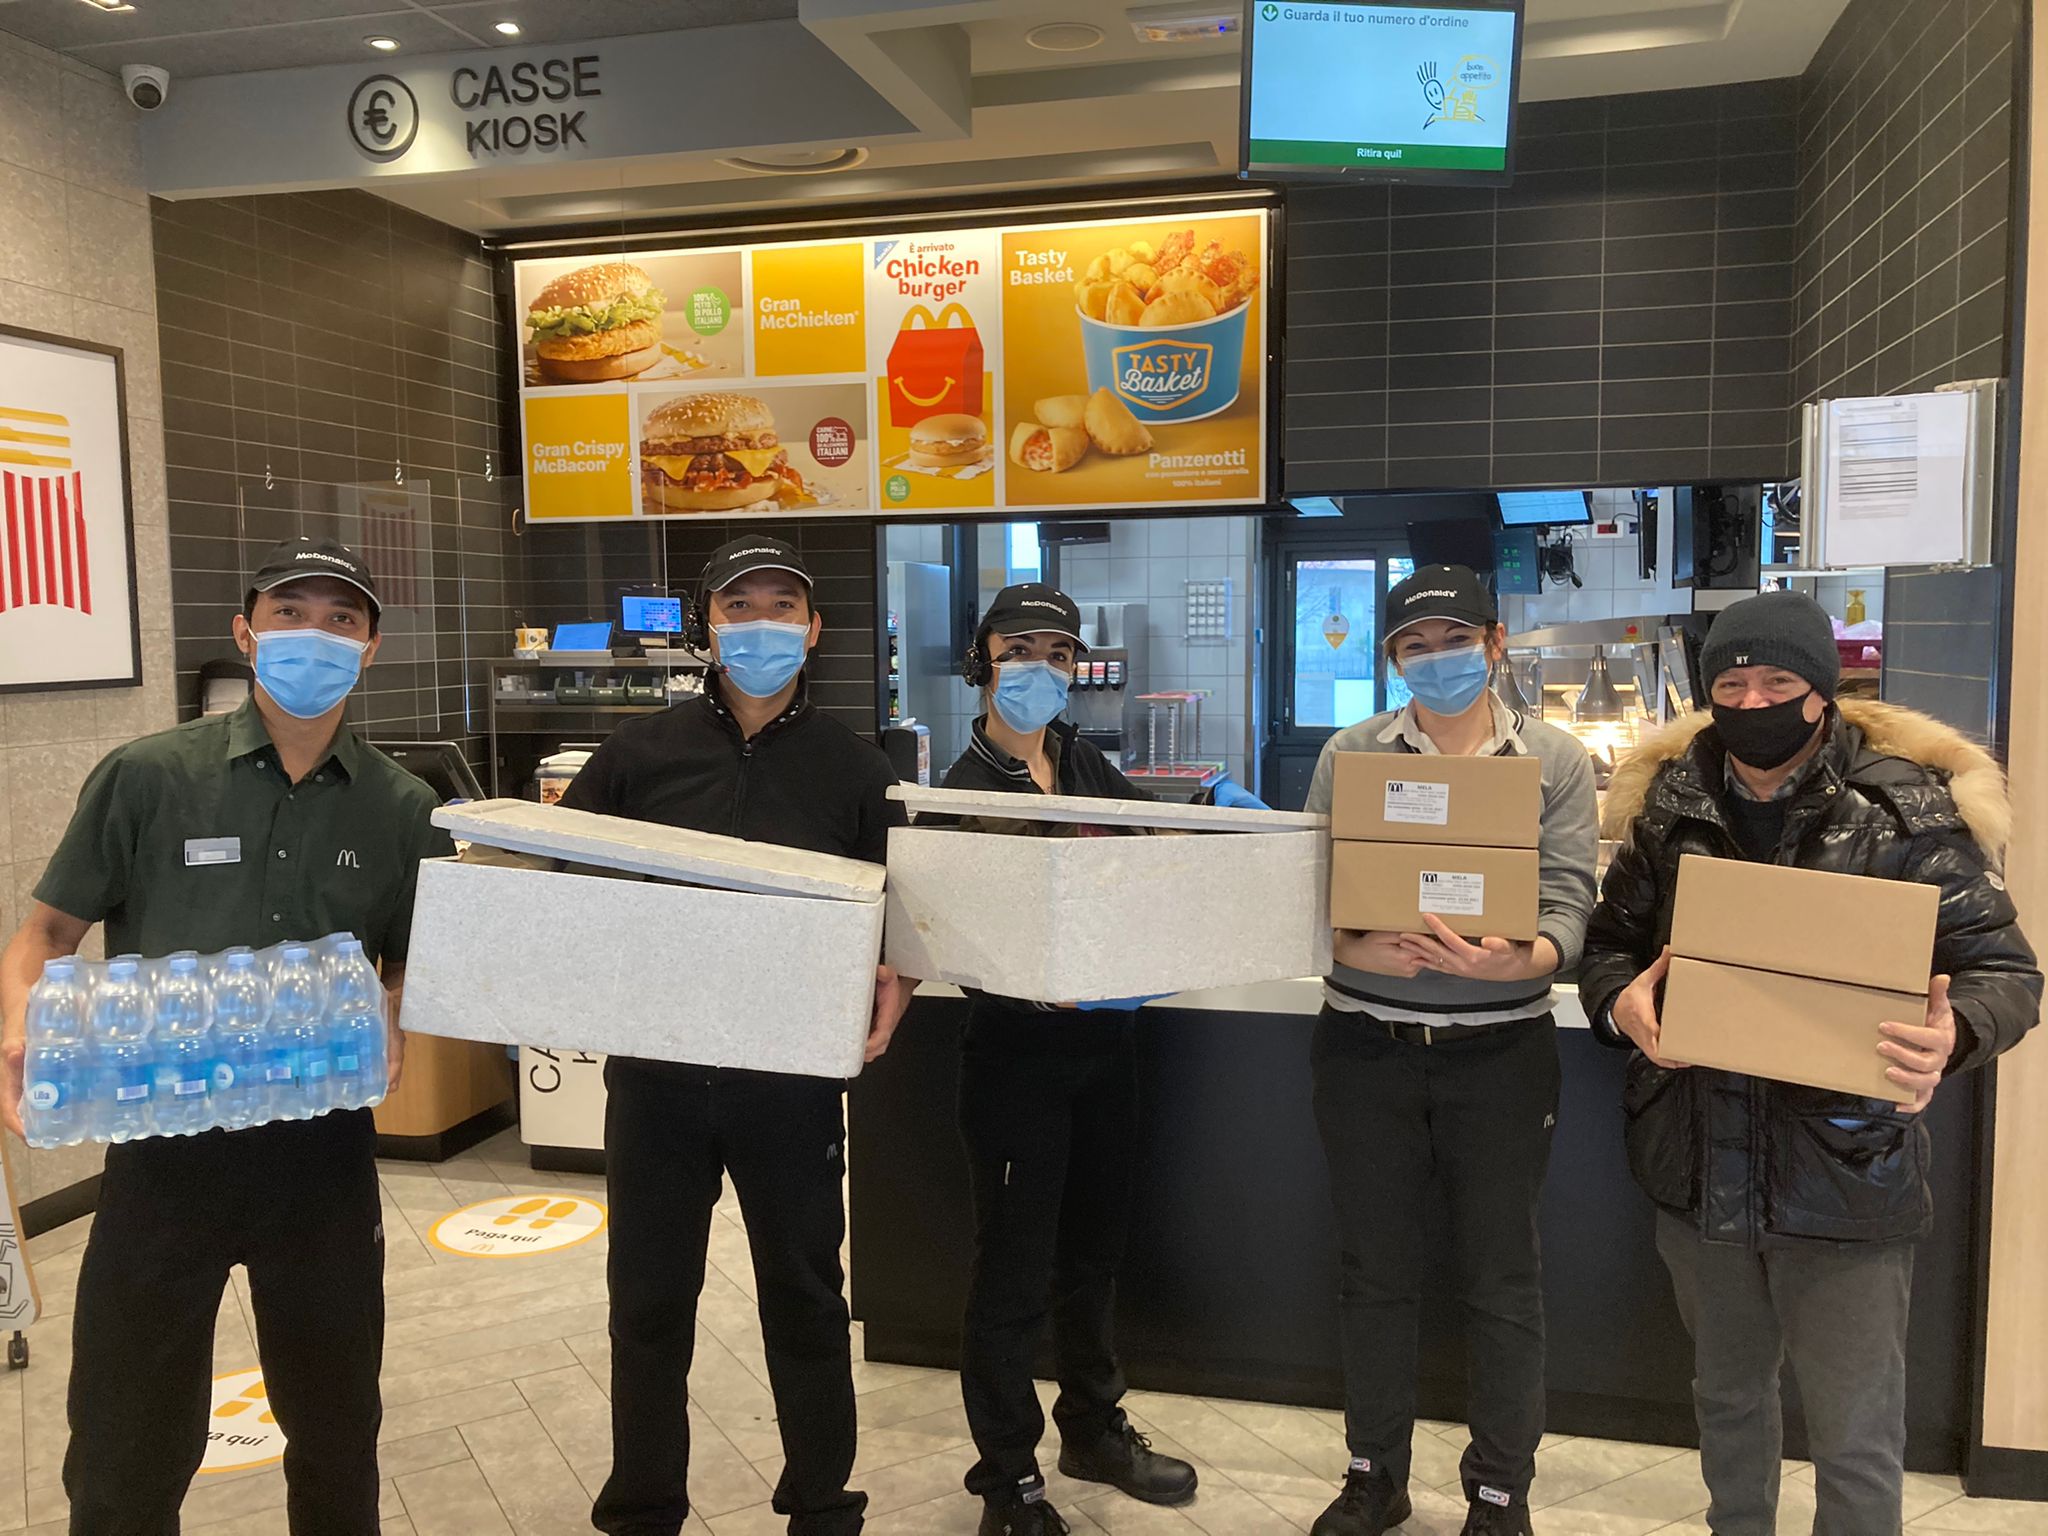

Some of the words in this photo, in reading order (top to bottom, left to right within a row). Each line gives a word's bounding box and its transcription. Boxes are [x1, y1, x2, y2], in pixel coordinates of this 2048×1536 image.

[1284, 8, 1329, 22] Guarda
[1333, 10, 1340, 22] il
[1344, 12, 1364, 23] tuo
[1368, 14, 1415, 25] numero
[1419, 15, 1469, 27] d'ordine
[453, 55, 602, 108] CASSE
[466, 110, 586, 153] KIOSK
[1357, 148, 1382, 158] Ritira
[1384, 149, 1402, 160] qui!
[917, 243, 955, 253] arrivato
[886, 254, 979, 279] Chicken
[1015, 249, 1067, 268] Tasty
[1010, 267, 1074, 286] Basket
[898, 278, 967, 302] burger
[760, 296, 800, 313] Gran
[1129, 351, 1197, 374] TASTY
[1120, 366, 1202, 392] Basket
[532, 443, 571, 457] Gran
[573, 440, 625, 458] Crispy
[1149, 448, 1245, 468] Panzerotti
[1736, 655, 1749, 665] NY
[464, 1227, 507, 1240] Paga
[510, 1235, 541, 1243] qui
[226, 1434, 269, 1446] qui
